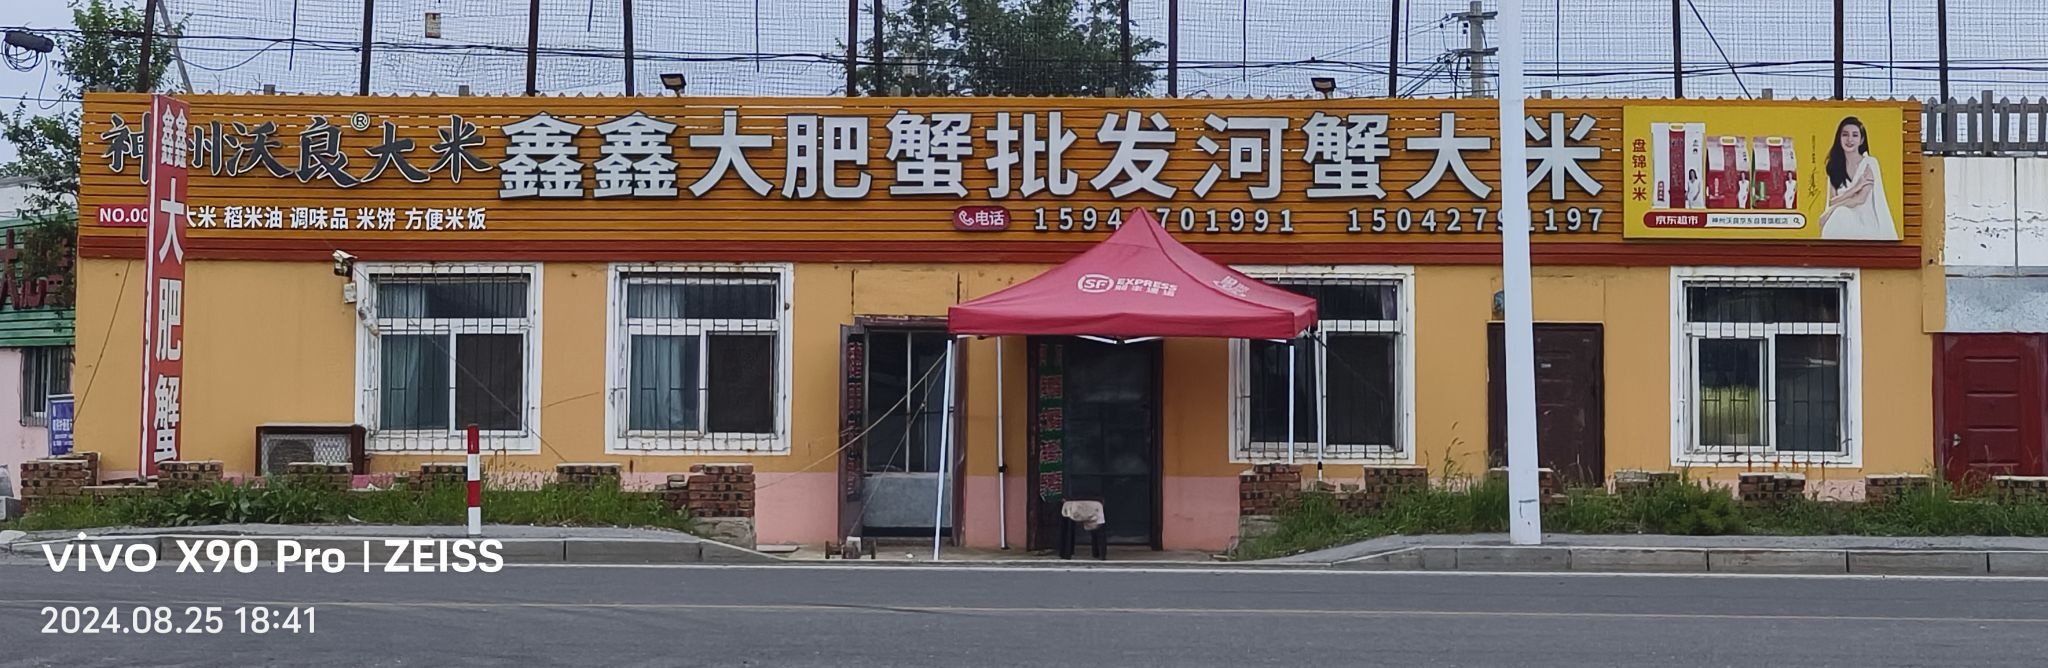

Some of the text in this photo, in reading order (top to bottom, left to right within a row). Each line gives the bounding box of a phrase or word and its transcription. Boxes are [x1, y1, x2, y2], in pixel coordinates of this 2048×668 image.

[498, 109, 1604, 200] 鑫鑫大肥蟹批发河蟹大米
[1632, 139, 1647, 202] 盘锦大米
[223, 206, 283, 229] 稻米油
[290, 206, 349, 230] 调味品
[356, 207, 396, 230] 米饼
[405, 207, 487, 231] 方便米饭
[974, 209, 1005, 226] 电话
[1034, 207, 1295, 232] 1594701991
[1655, 215, 1699, 226] 京东超市
[1116, 278, 1178, 291] EXPRESS
